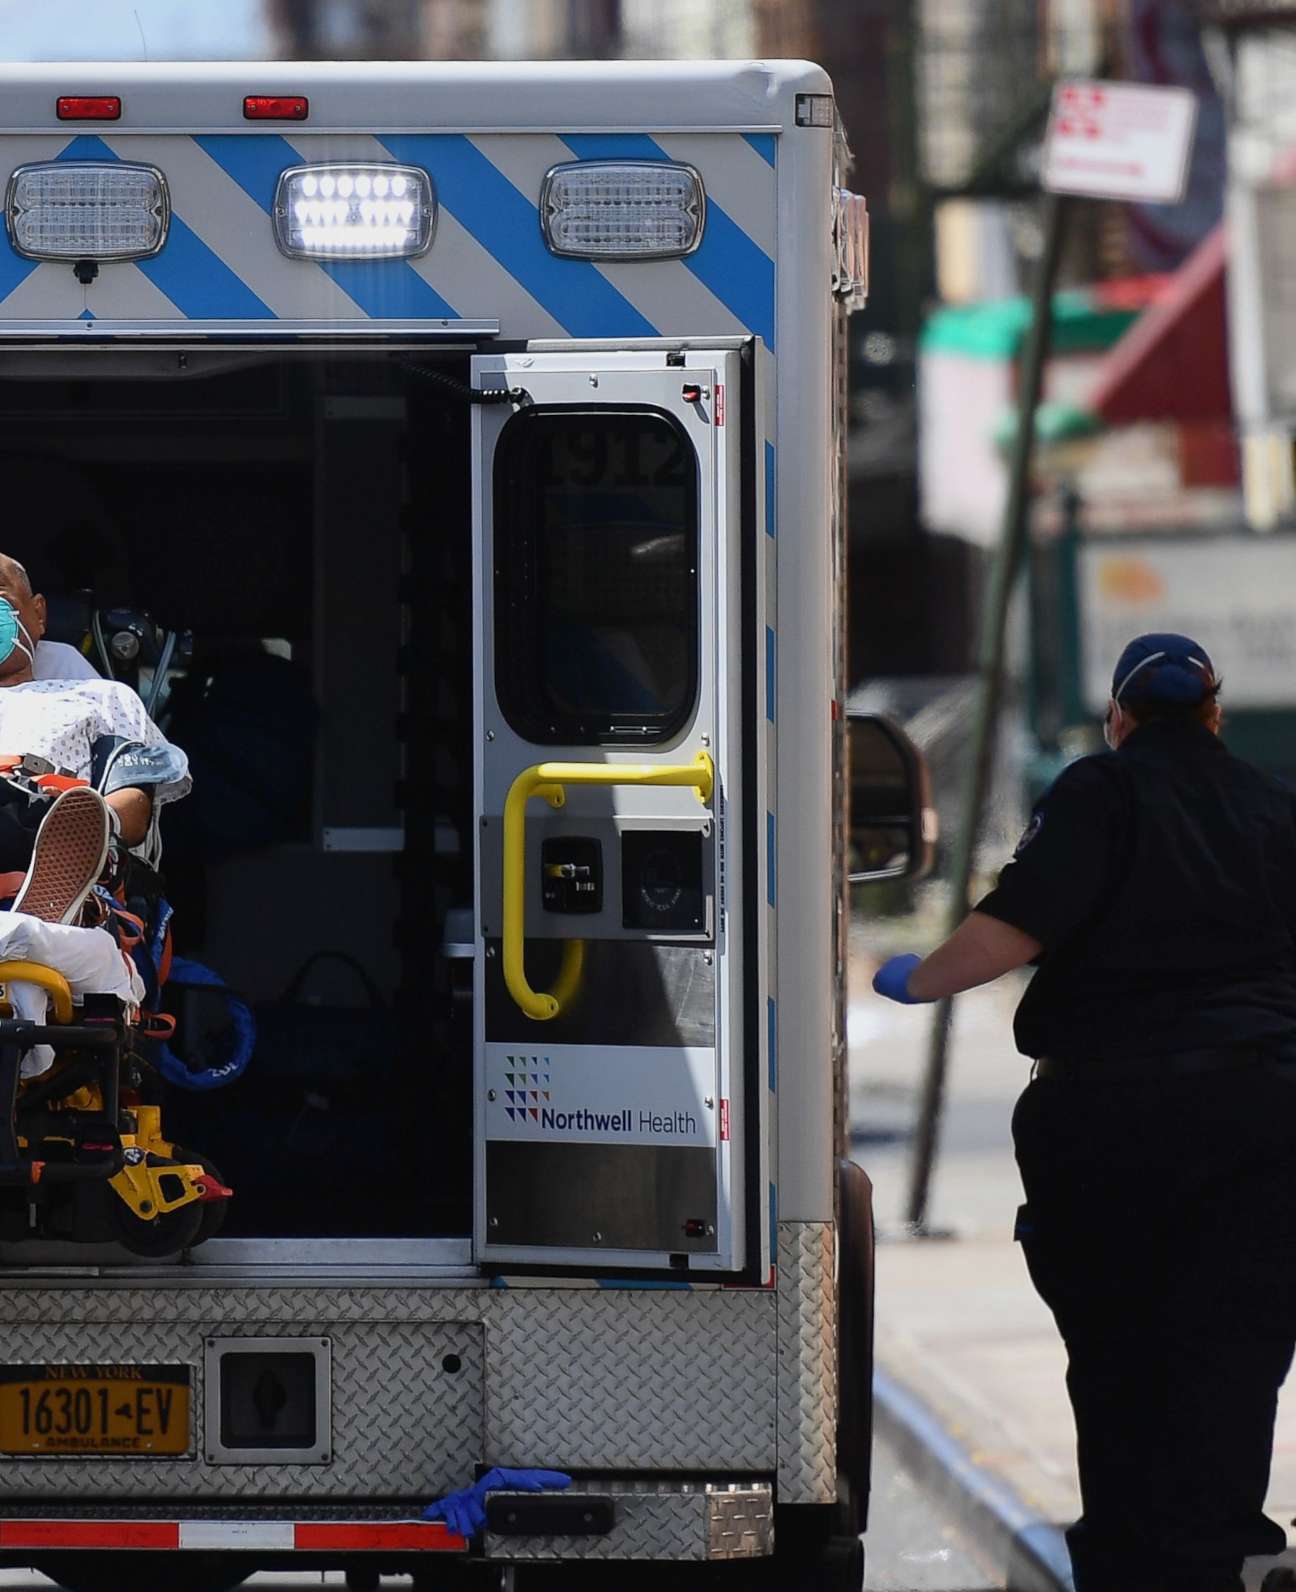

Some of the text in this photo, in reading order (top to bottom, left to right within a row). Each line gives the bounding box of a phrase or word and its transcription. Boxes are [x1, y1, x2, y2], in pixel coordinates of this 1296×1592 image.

[542, 1108, 631, 1132] Northwell
[639, 1111, 696, 1133] Health
[45, 1365, 142, 1379] NEW YORK
[45, 1437, 141, 1448] AMBULANCE
